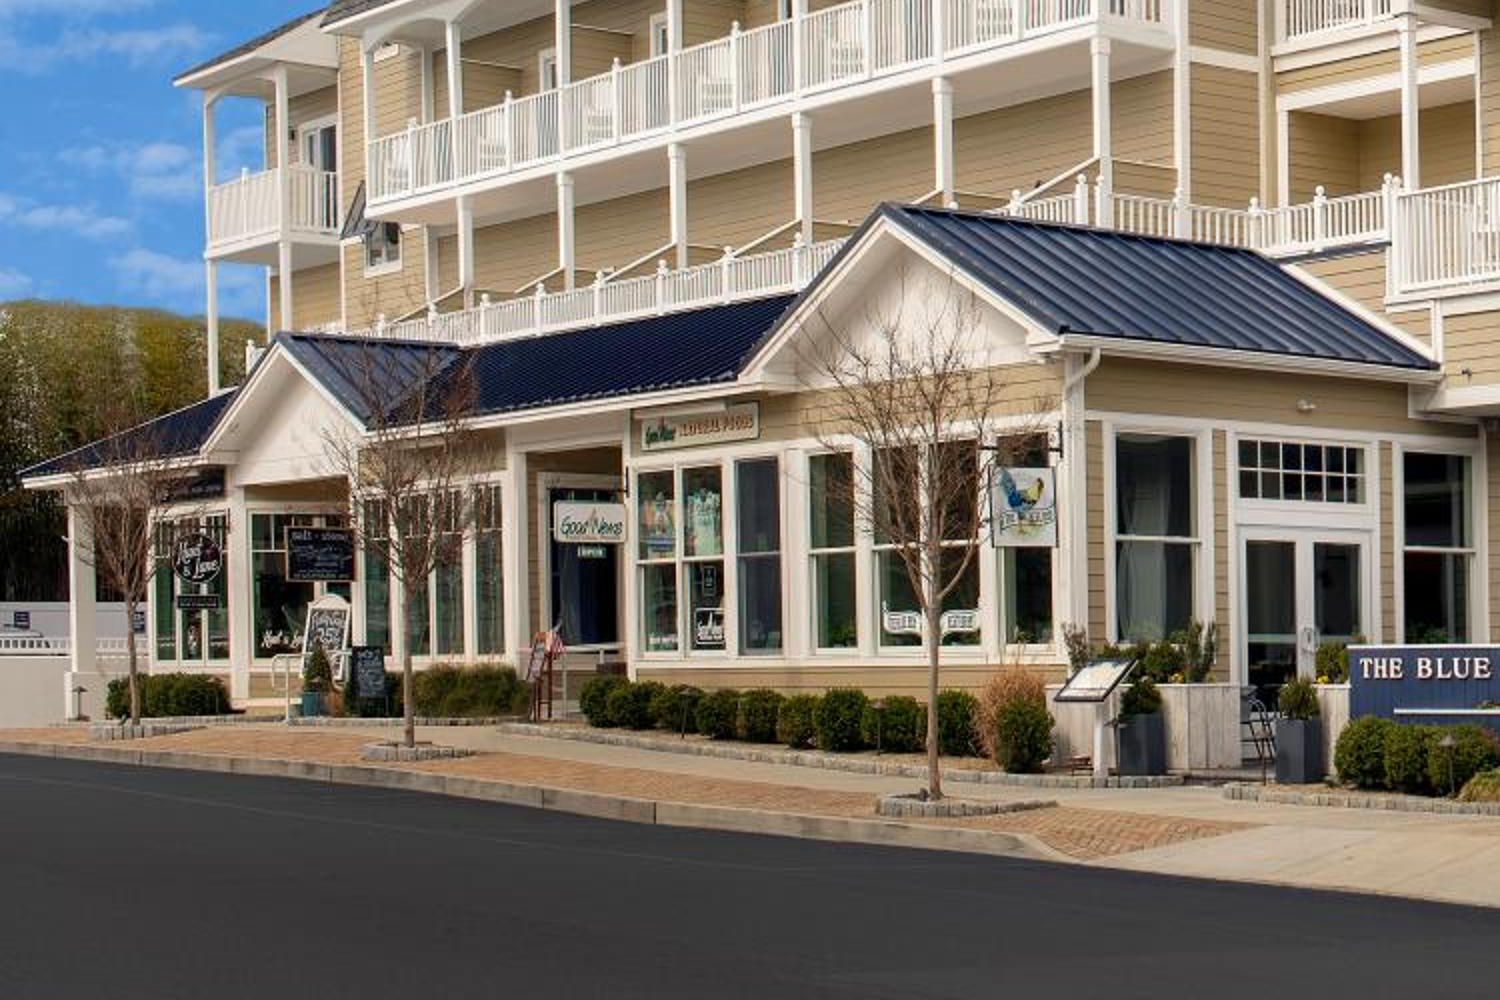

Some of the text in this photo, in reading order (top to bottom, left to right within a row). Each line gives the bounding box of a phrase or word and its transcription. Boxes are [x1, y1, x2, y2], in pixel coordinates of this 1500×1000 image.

[560, 514, 624, 538] Good News
[1359, 657, 1404, 680] THE
[1417, 657, 1492, 680] BLUE
